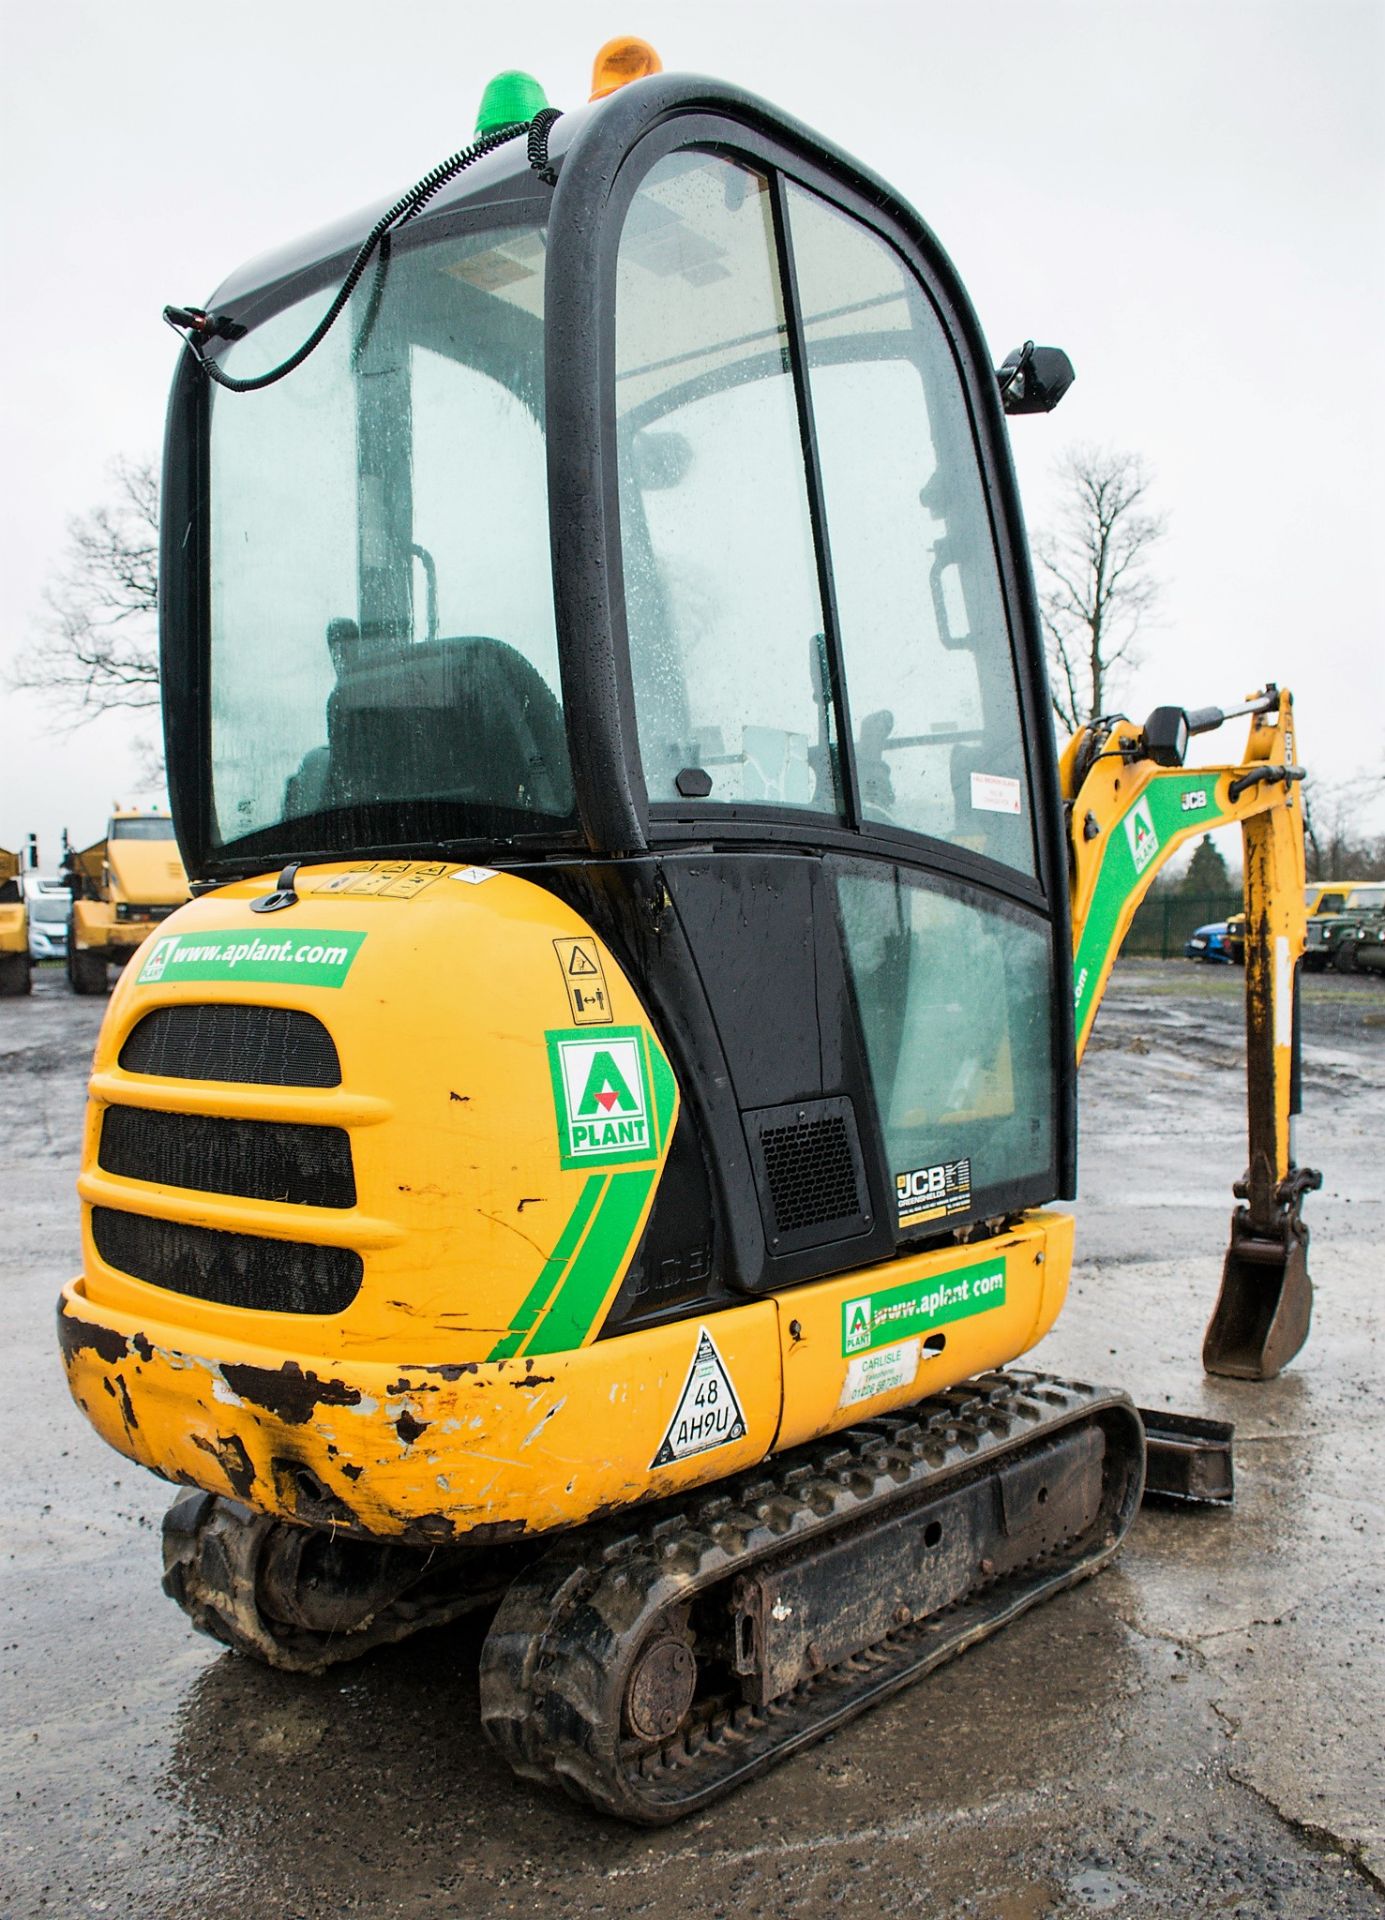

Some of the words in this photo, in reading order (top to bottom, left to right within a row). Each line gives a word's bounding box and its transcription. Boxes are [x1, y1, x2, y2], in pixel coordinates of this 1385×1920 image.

[1181, 790, 1206, 811] JCB
[1133, 812, 1152, 850] A
[148, 941, 171, 966] A
[172, 937, 349, 968] www.aplant.com
[577, 1050, 640, 1116] A
[571, 1119, 646, 1148] PLANT
[896, 1165, 946, 1200] JCB
[849, 1306, 869, 1335] A
[847, 1333, 870, 1348] PLANT
[862, 1350, 902, 1372] CARLISLE
[694, 1379, 719, 1408] 48
[676, 1406, 729, 1446] AH9U
